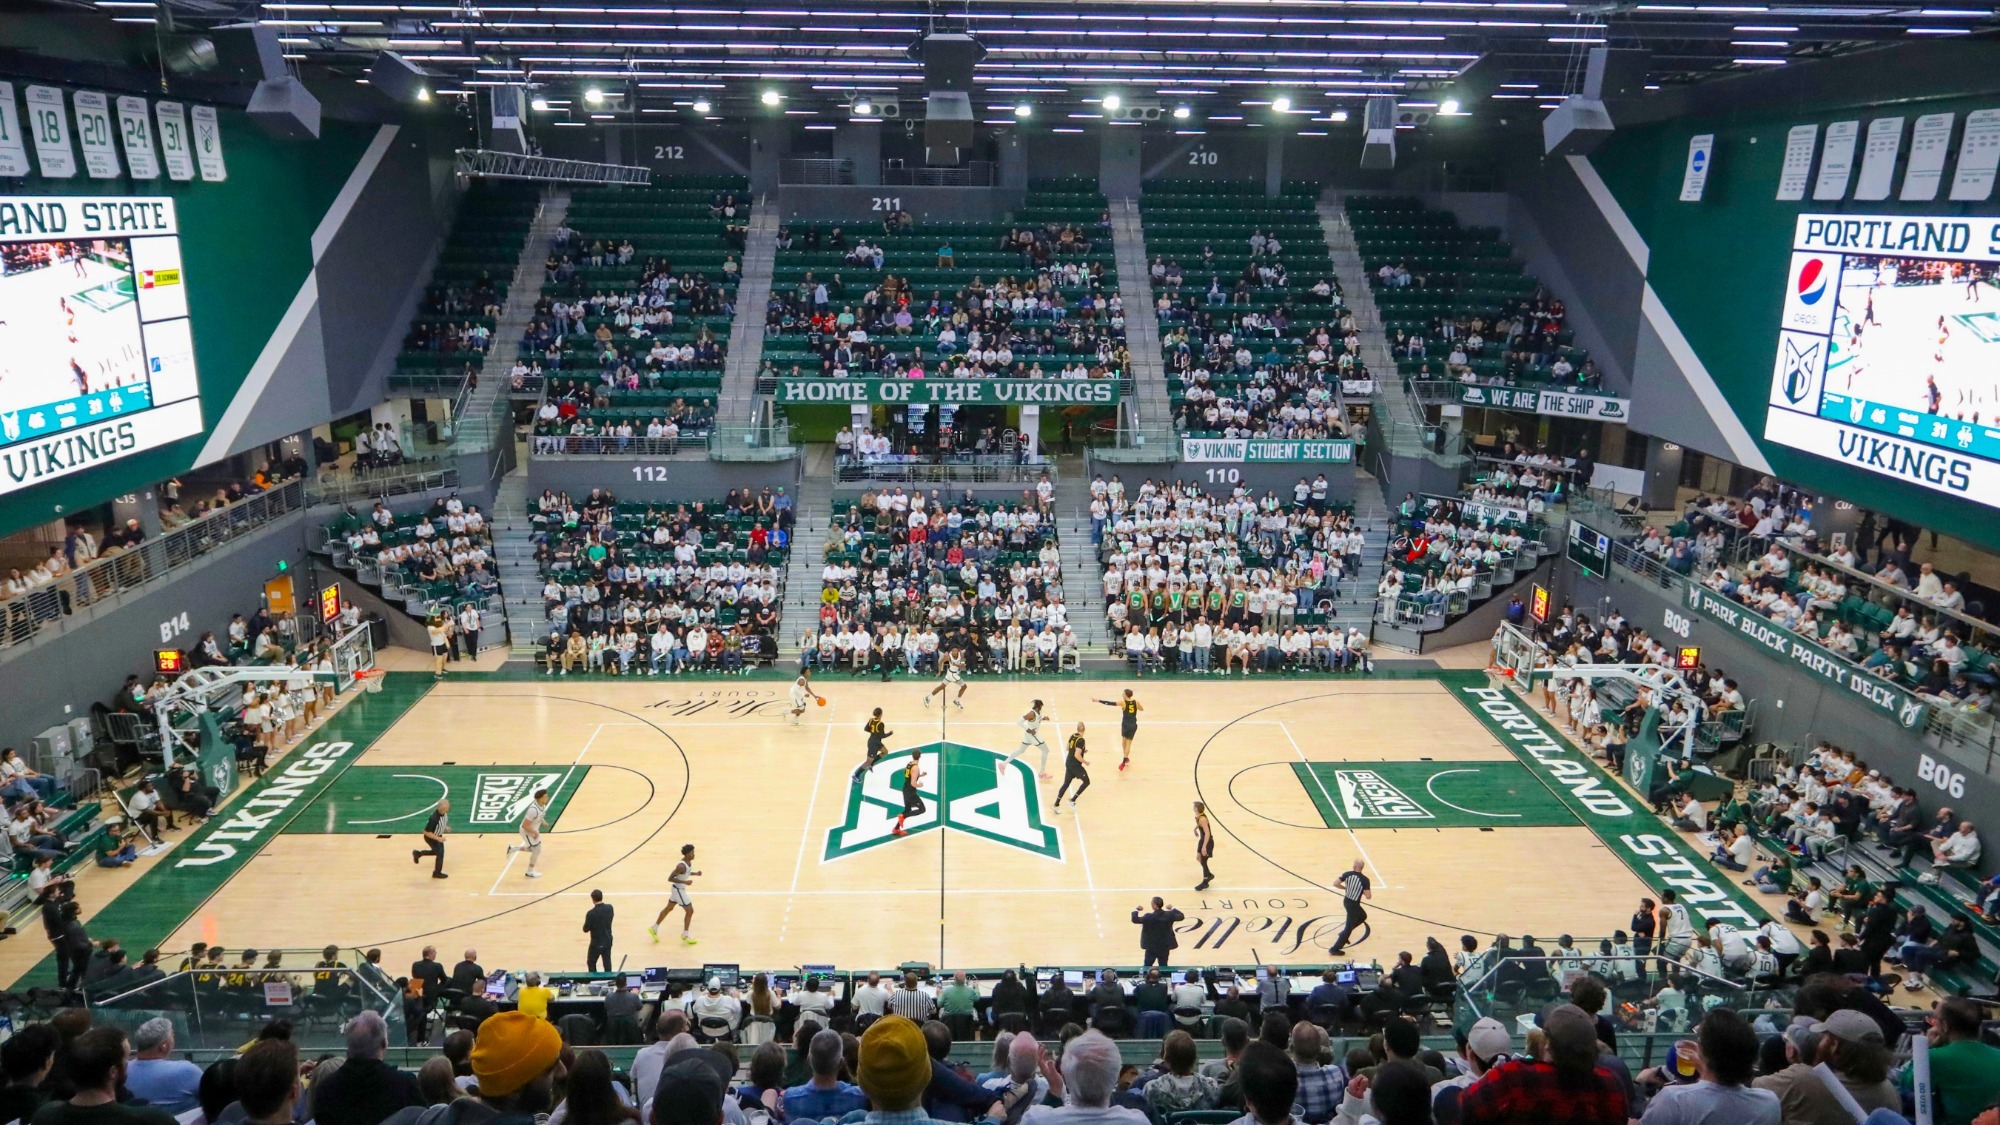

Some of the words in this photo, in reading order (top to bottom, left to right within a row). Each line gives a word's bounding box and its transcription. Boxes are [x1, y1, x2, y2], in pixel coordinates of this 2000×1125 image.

[37, 109, 61, 144] 18
[81, 113, 107, 146] 20
[123, 117, 148, 149] 24
[164, 121, 183, 152] 31
[654, 145, 684, 160] 212
[1188, 151, 1218, 165] 210
[871, 197, 900, 211] 211
[82, 202, 168, 232] STATE
[1804, 218, 1971, 254] PORTLAND
[784, 382, 869, 401] HOME
[879, 382, 914, 401] OF
[925, 382, 983, 402] THE
[993, 383, 1112, 402] VIKINGS
[1491, 389, 1509, 407] WE
[1512, 390, 1536, 410] ARE
[1543, 394, 1567, 412] THE
[1568, 396, 1595, 415] SHIP
[1931, 422, 1948, 439] 31
[3, 421, 136, 483] VIKINGS
[1203, 442, 1243, 459] VIKING
[1248, 442, 1300, 459] STUDENT
[1302, 442, 1350, 460] SECTION
[1838, 429, 1972, 492] VIKINGS
[632, 466, 668, 482] 112
[1205, 468, 1240, 484] 110
[1466, 503, 1482, 518] THE
[1483, 506, 1501, 521] SHIP
[324, 598, 337, 618] 28
[159, 611, 190, 644] B14
[1663, 607, 1690, 639] B08
[1681, 656, 1695, 666] 28
[1703, 596, 1738, 627] PARK
[1740, 617, 1787, 653] BLOCK
[1790, 642, 1847, 684] PARTY
[1850, 674, 1896, 712] DECK
[160, 659, 175, 670] 28
[1128, 704, 1135, 714] 5
[1462, 686, 1634, 817] PORTLAND
[1917, 753, 1966, 799] B06
[174, 741, 355, 868] VIKINGS
[1200, 898, 1309, 910] COURT
[1676, 909, 1684, 921] 7
[1174, 914, 1372, 956] Stolle
[1600, 962, 1609, 974] 6
[1760, 960, 1772, 972] 10
[229, 973, 243, 986] 24
